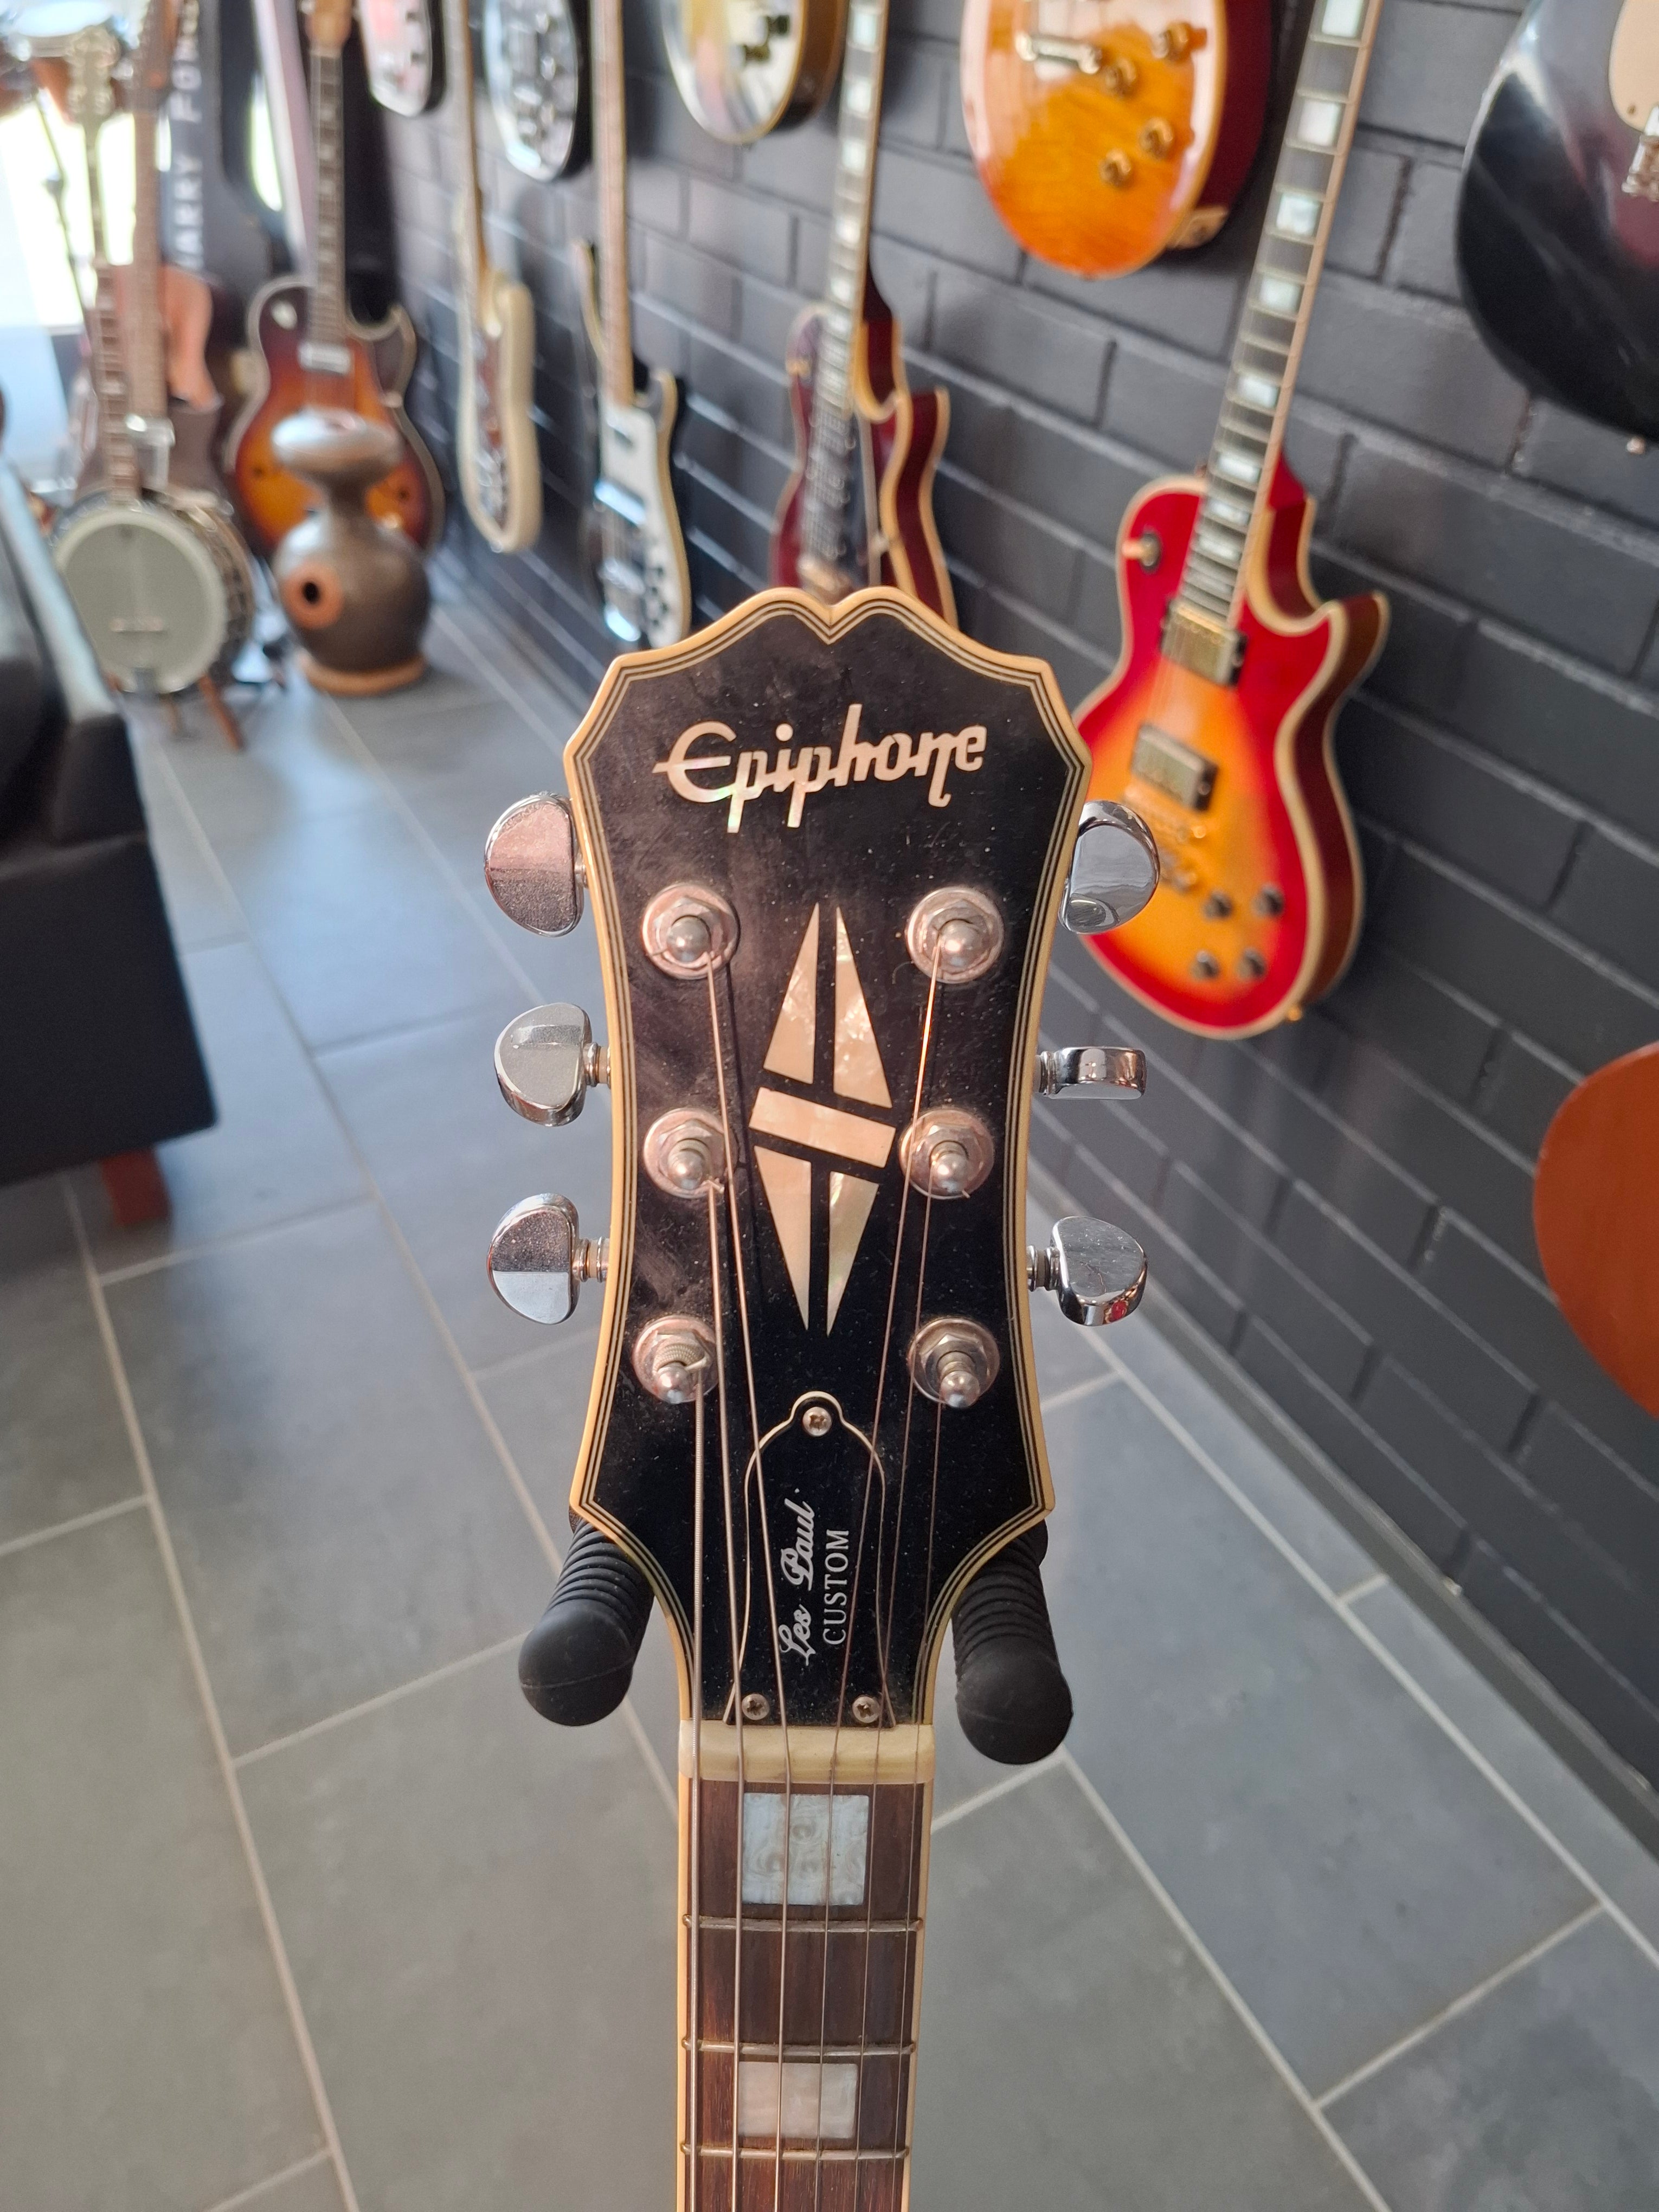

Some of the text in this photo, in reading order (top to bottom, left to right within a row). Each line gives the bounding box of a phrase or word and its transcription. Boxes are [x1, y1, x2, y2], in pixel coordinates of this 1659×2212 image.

[652, 704, 987, 833] Epiphone
[778, 1498, 816, 1666] Les Paul
[822, 1528, 850, 1645] CUSTOM
